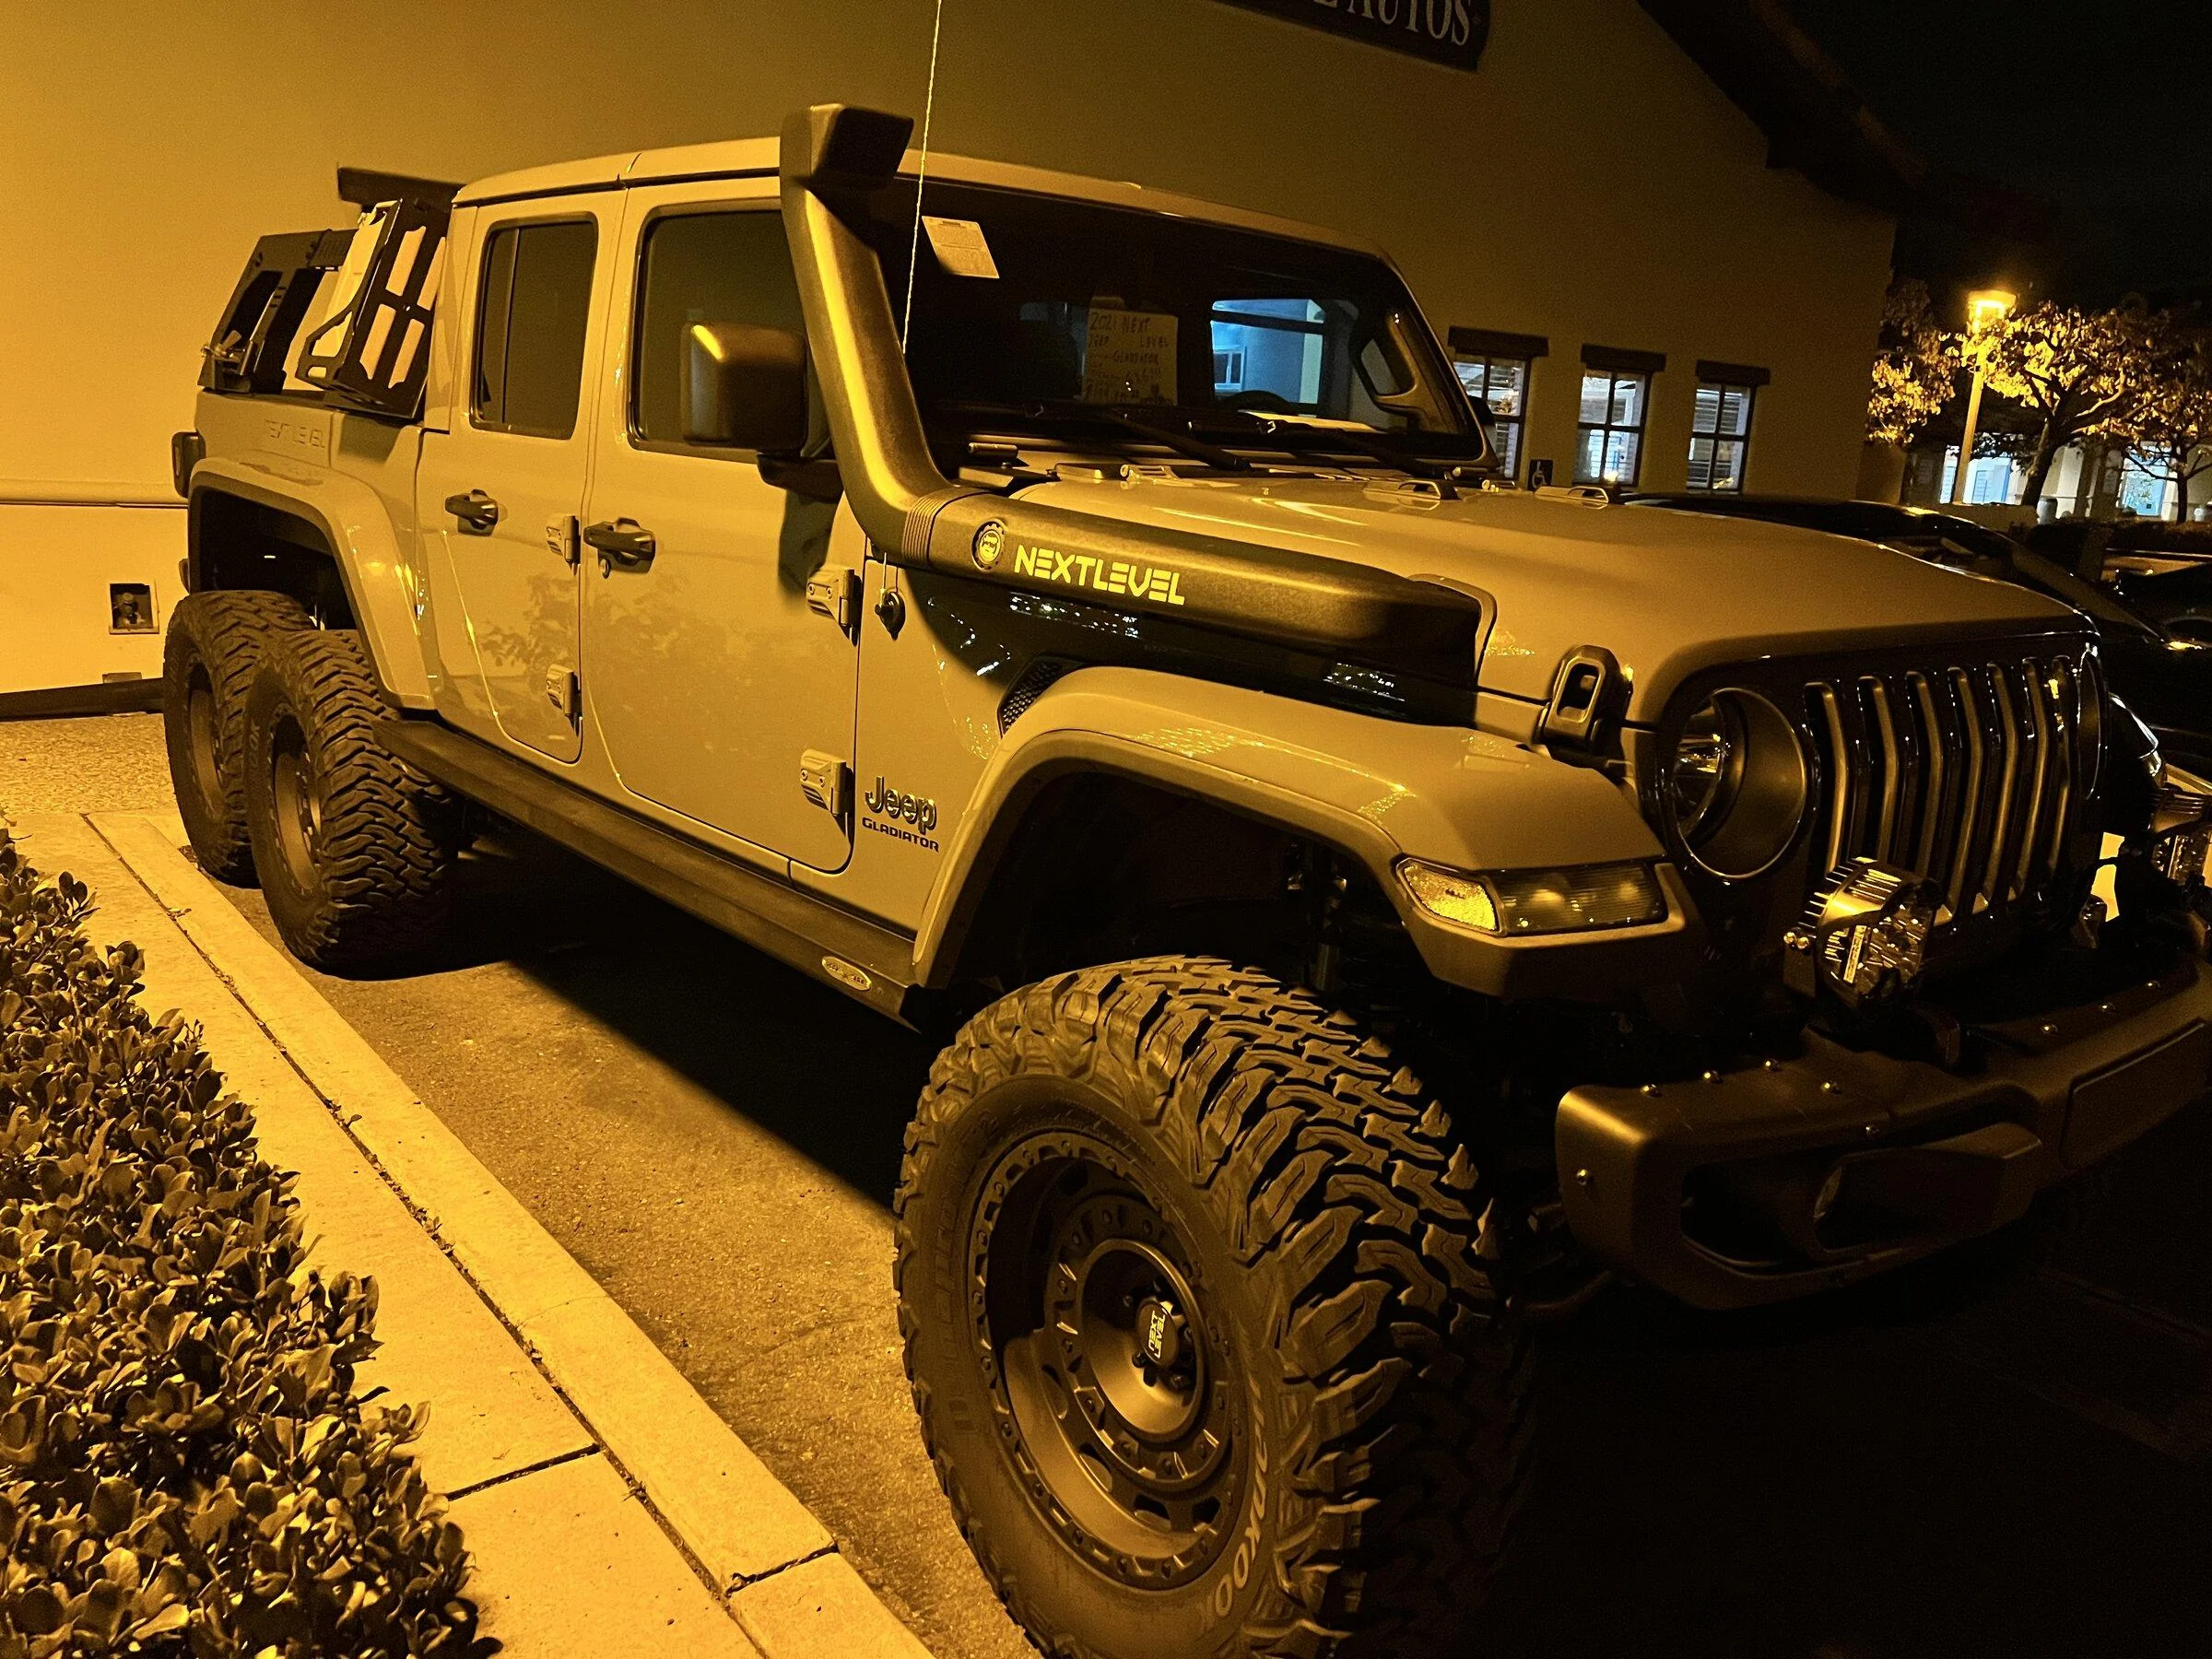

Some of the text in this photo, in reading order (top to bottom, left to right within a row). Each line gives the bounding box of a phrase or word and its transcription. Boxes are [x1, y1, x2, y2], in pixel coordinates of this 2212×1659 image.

[1089, 312, 1117, 331] 2021
[1014, 544, 1185, 606] NEXTLEVEL
[865, 775, 936, 835] Jeep
[862, 817, 940, 853] GLADIATOR
[1147, 1310, 1159, 1351] NEXT
[1154, 1313, 1166, 1359] LEVEL
